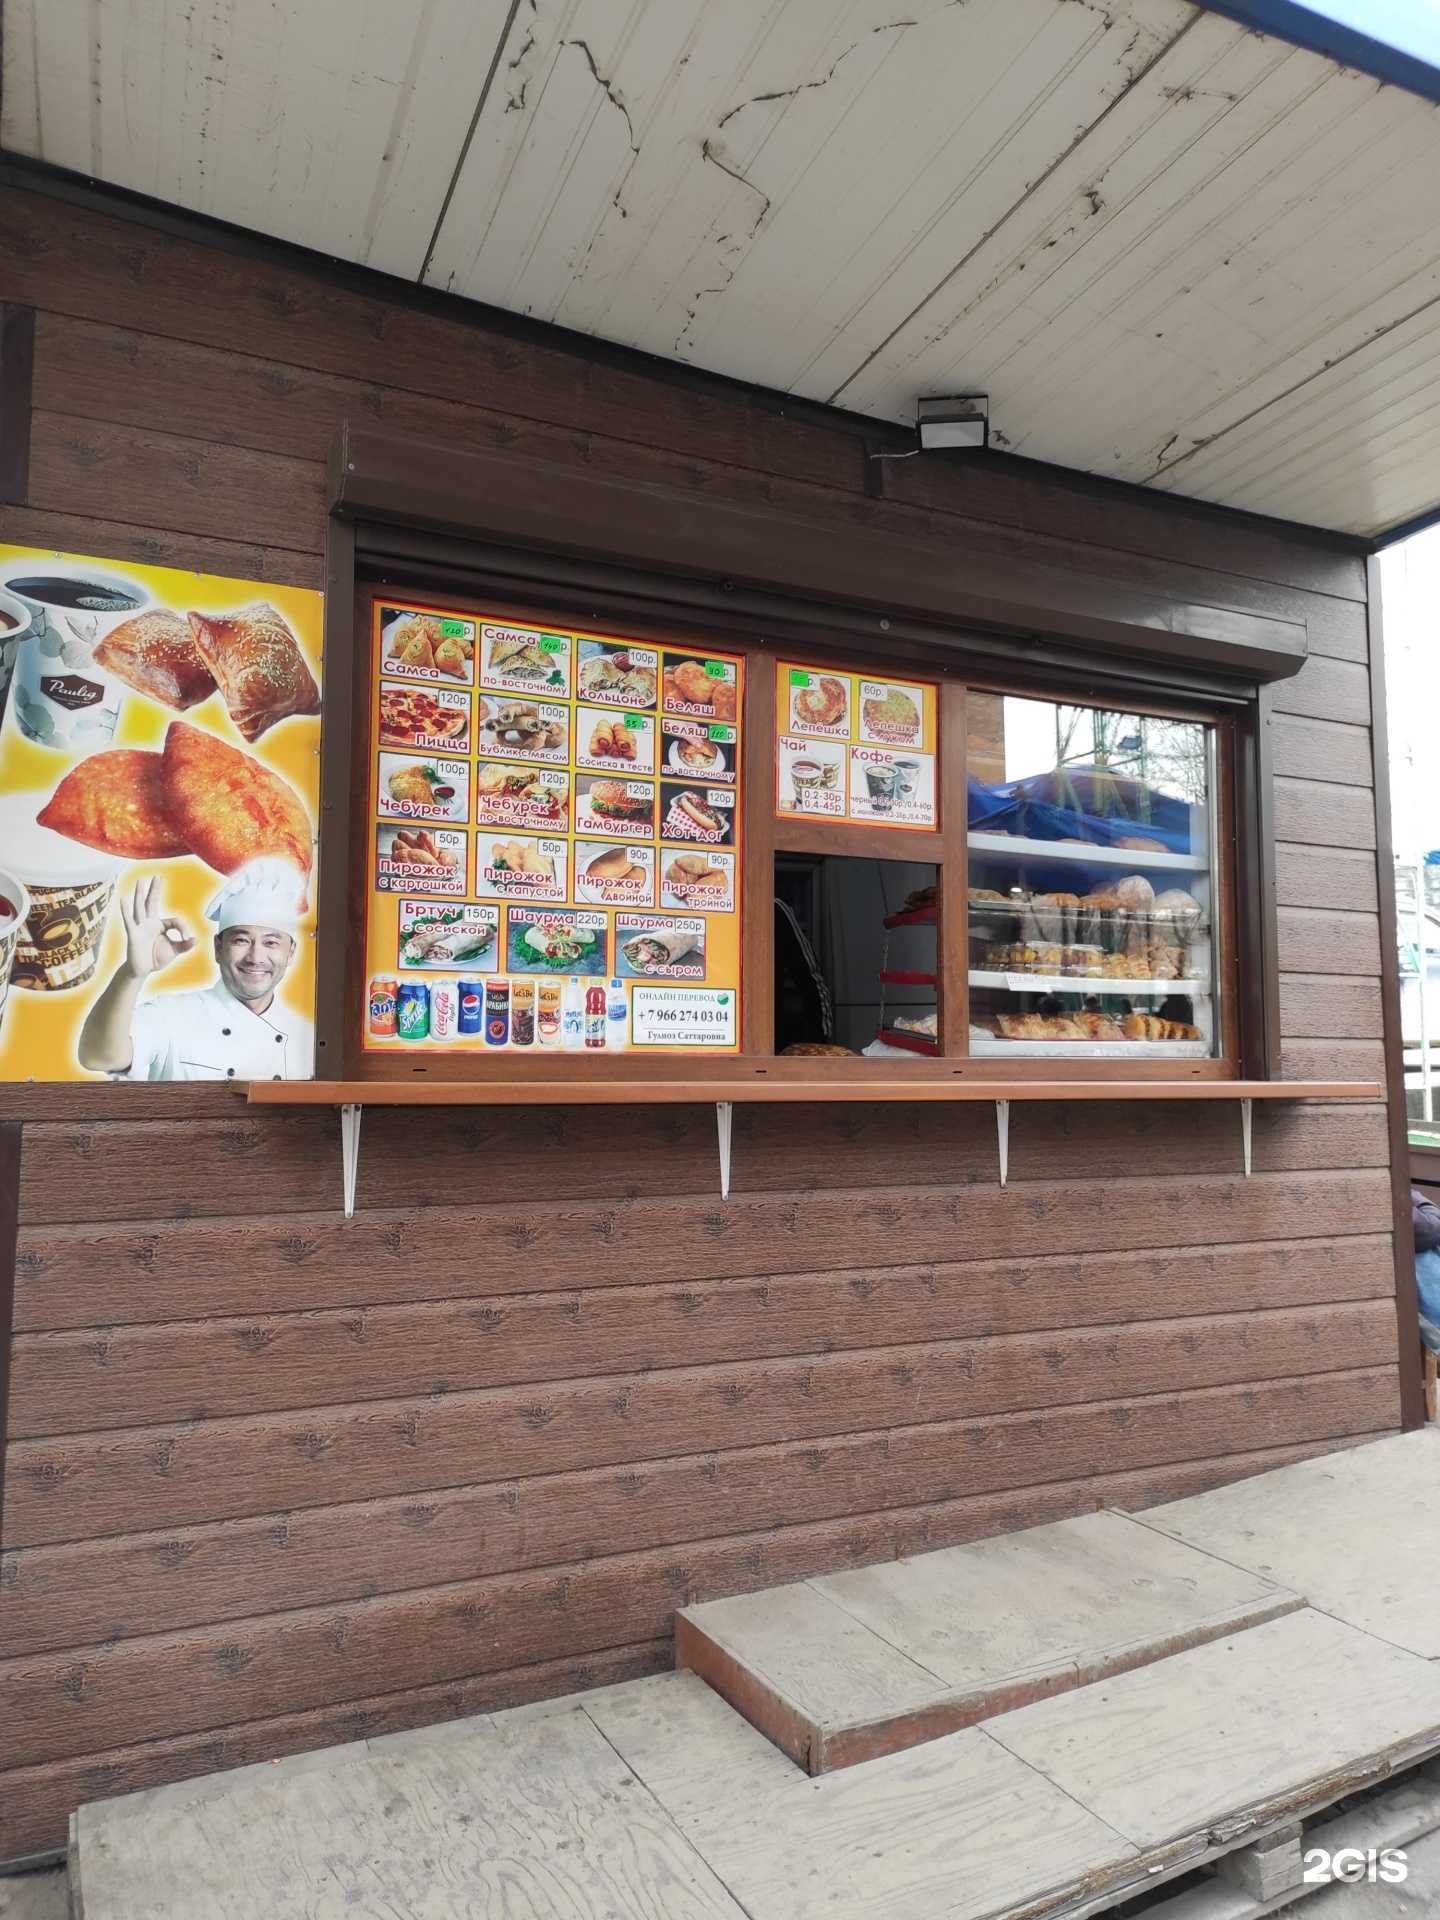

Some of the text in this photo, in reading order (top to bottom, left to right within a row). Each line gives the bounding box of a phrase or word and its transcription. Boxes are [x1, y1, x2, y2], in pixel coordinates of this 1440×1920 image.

[484, 628, 536, 645] Самса
[384, 661, 439, 678] Самса
[48, 679, 97, 701] Paulig
[483, 677, 567, 696] по-восточному
[579, 688, 647, 706] Кольцоне
[666, 698, 714, 715] Беляш
[663, 722, 707, 737] Беляш
[416, 734, 468, 750] Пицца
[780, 739, 807, 751] Чай
[578, 756, 617, 769] Сосиска
[627, 763, 653, 772] тесте
[851, 747, 893, 765] Кофе
[662, 765, 735, 783] по-восточному
[380, 799, 450, 816] Чебурек
[481, 797, 549, 815] Чебурек
[480, 813, 563, 828] по-восточному
[577, 817, 652, 835] Гамбургер
[663, 824, 722, 842] Хот-дог
[380, 860, 456, 877] Пирожок
[483, 867, 553, 884] Пирожок
[379, 878, 463, 891] с картошкой
[577, 874, 641, 889] Пирожок
[662, 881, 722, 897] Пирожок
[496, 885, 564, 898] с капустой
[605, 891, 652, 903] двойной
[405, 902, 456, 918] Бртуч
[688, 897, 732, 910] тройной
[510, 909, 574, 924] Шаурма
[617, 916, 673, 928] Шаурма
[402, 923, 486, 936] с сосиской
[645, 965, 702, 978] с сыром
[639, 991, 715, 1002] ОНЛАЙН ПЕРЕВОД
[648, 1009, 654, 1020] 7
[657, 1009, 677, 1021] 966
[679, 1010, 698, 1022] 274
[701, 1011, 713, 1022] 03
[716, 1011, 728, 1022] 04
